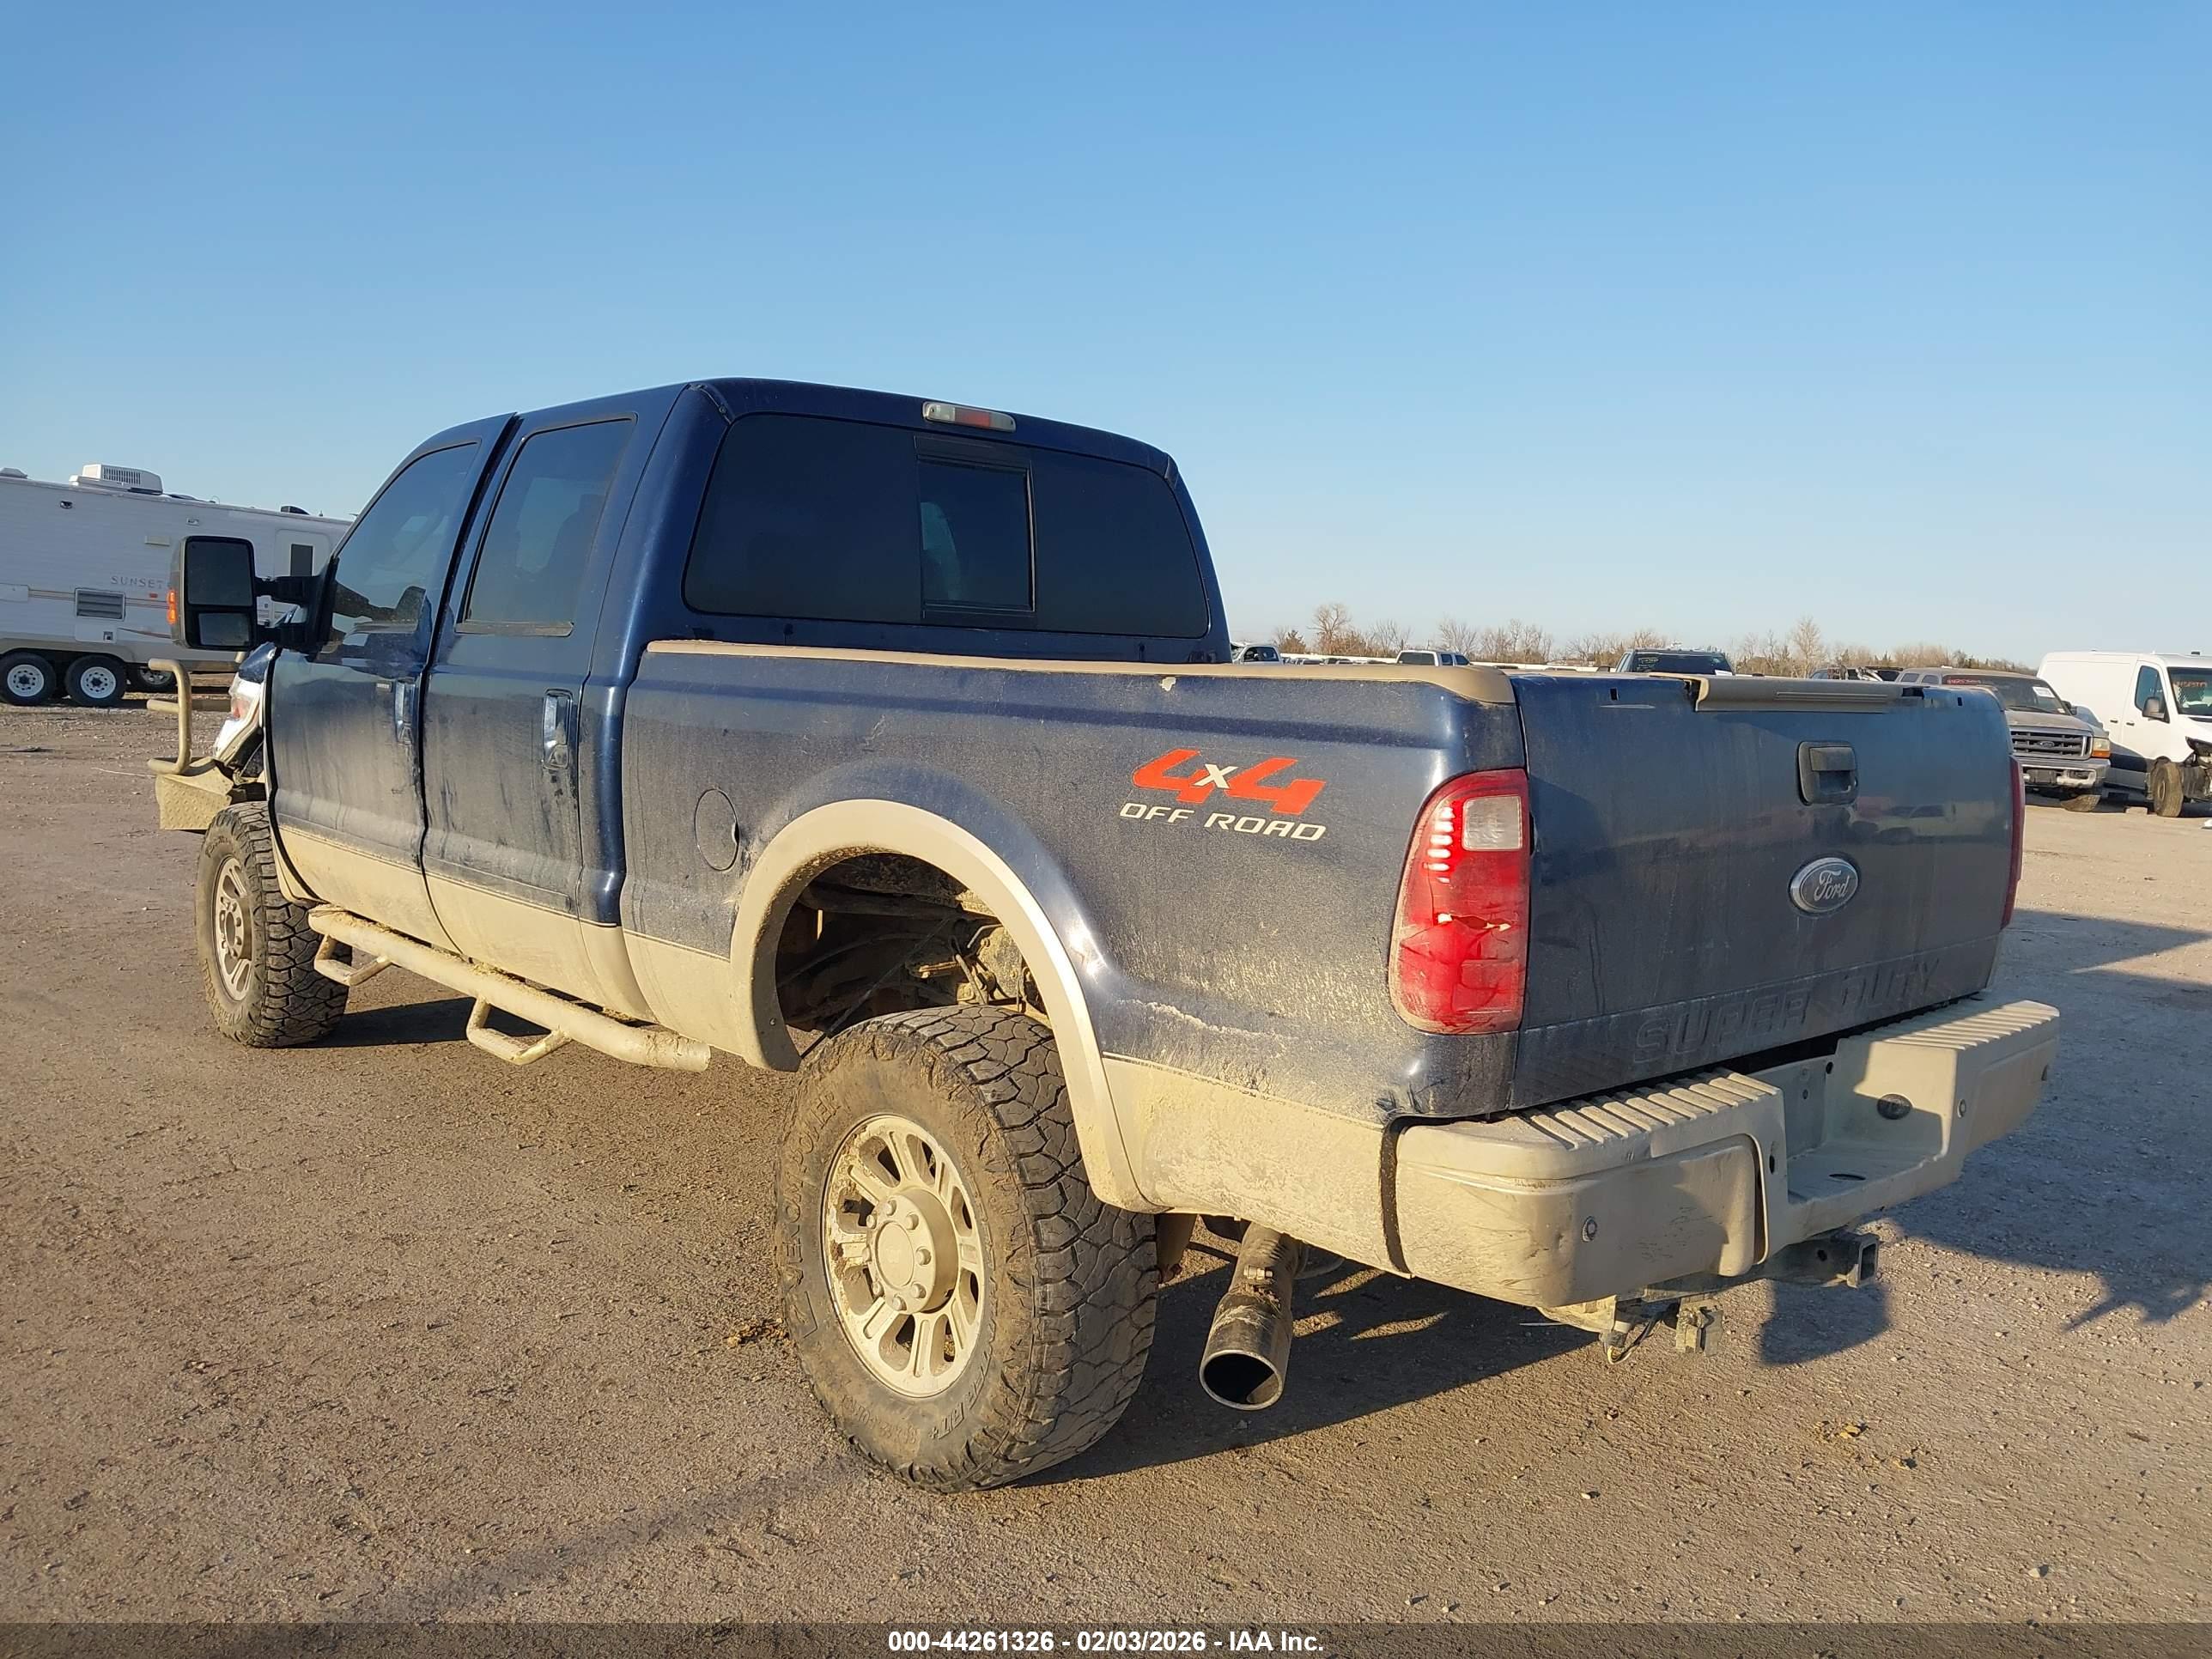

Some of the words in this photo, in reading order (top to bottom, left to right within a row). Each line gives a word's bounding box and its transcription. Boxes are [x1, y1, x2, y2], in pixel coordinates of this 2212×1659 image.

[110, 575, 164, 590] SUNSET
[1119, 802, 1195, 823] OFF
[1204, 812, 1327, 842] ROAD
[1814, 870, 1850, 902] Ford
[1634, 984, 1812, 1065] SUPER
